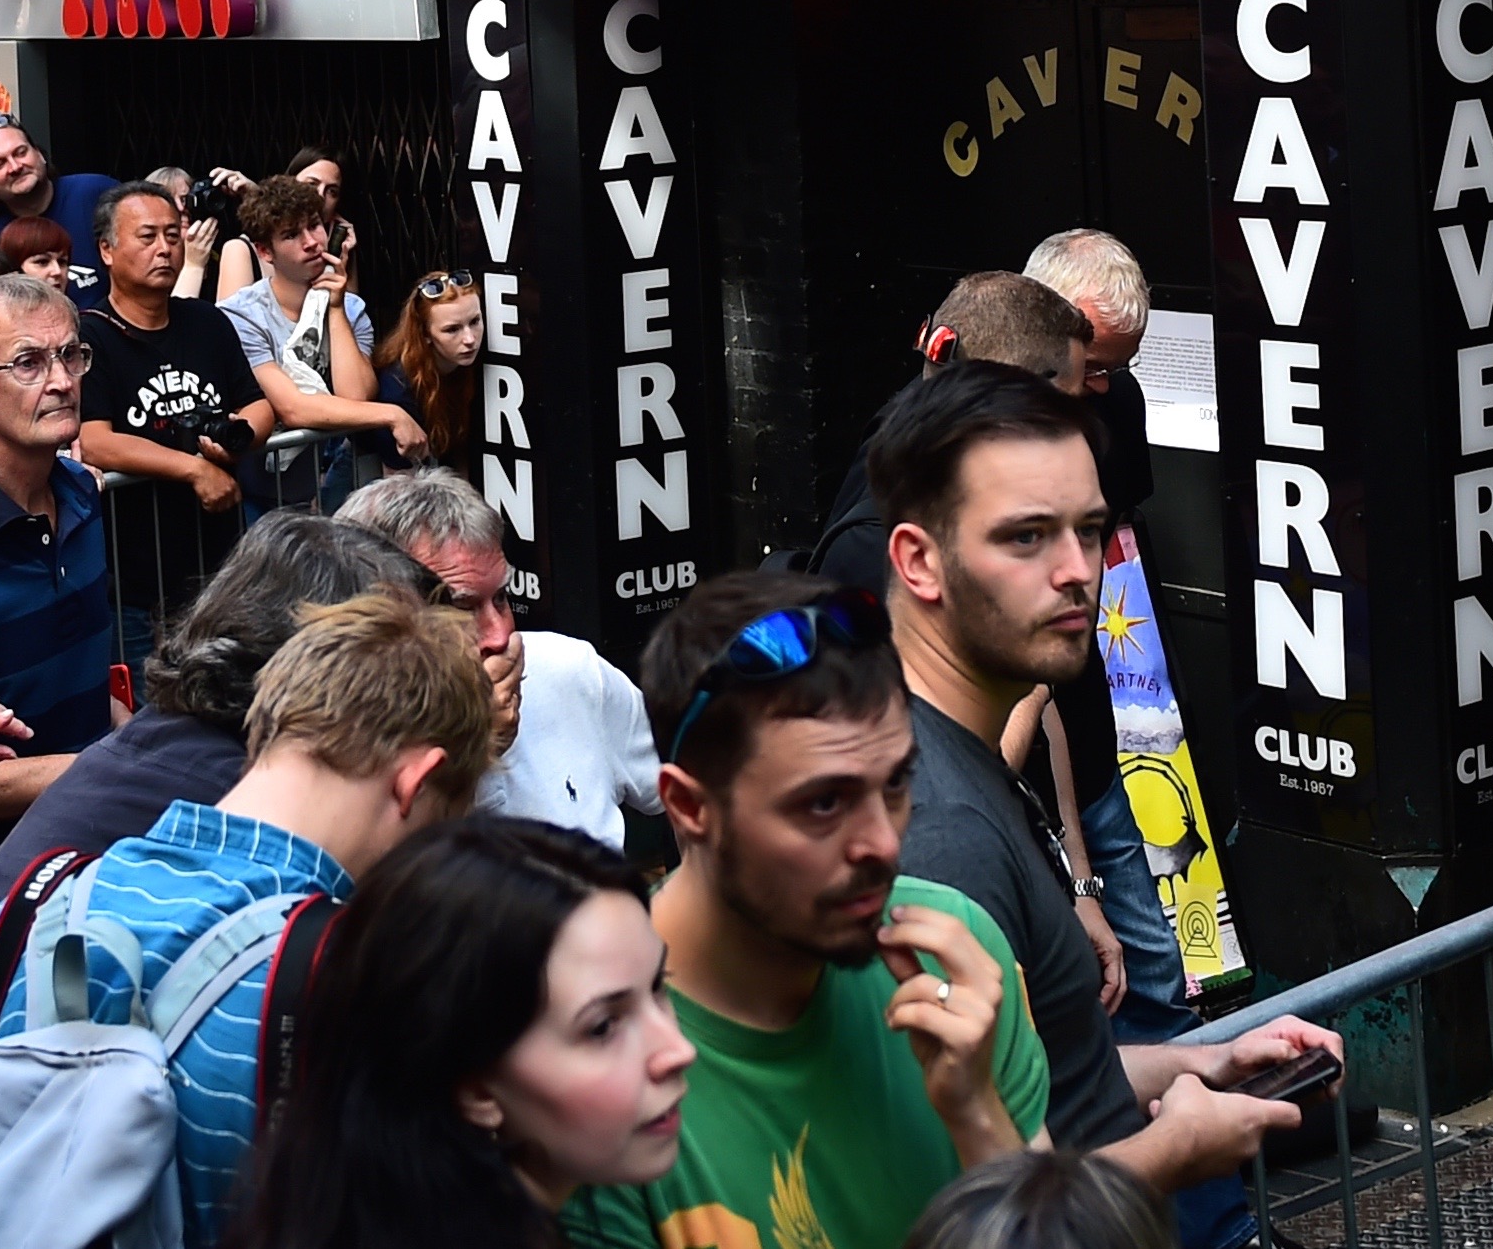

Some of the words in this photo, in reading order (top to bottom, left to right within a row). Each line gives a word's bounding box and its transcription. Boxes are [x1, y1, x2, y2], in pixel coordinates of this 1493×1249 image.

[127, 370, 222, 428] CAVERN
[155, 395, 196, 417] CLUB
[615, 560, 698, 600] CLUB
[1253, 726, 1357, 779] CLUB
